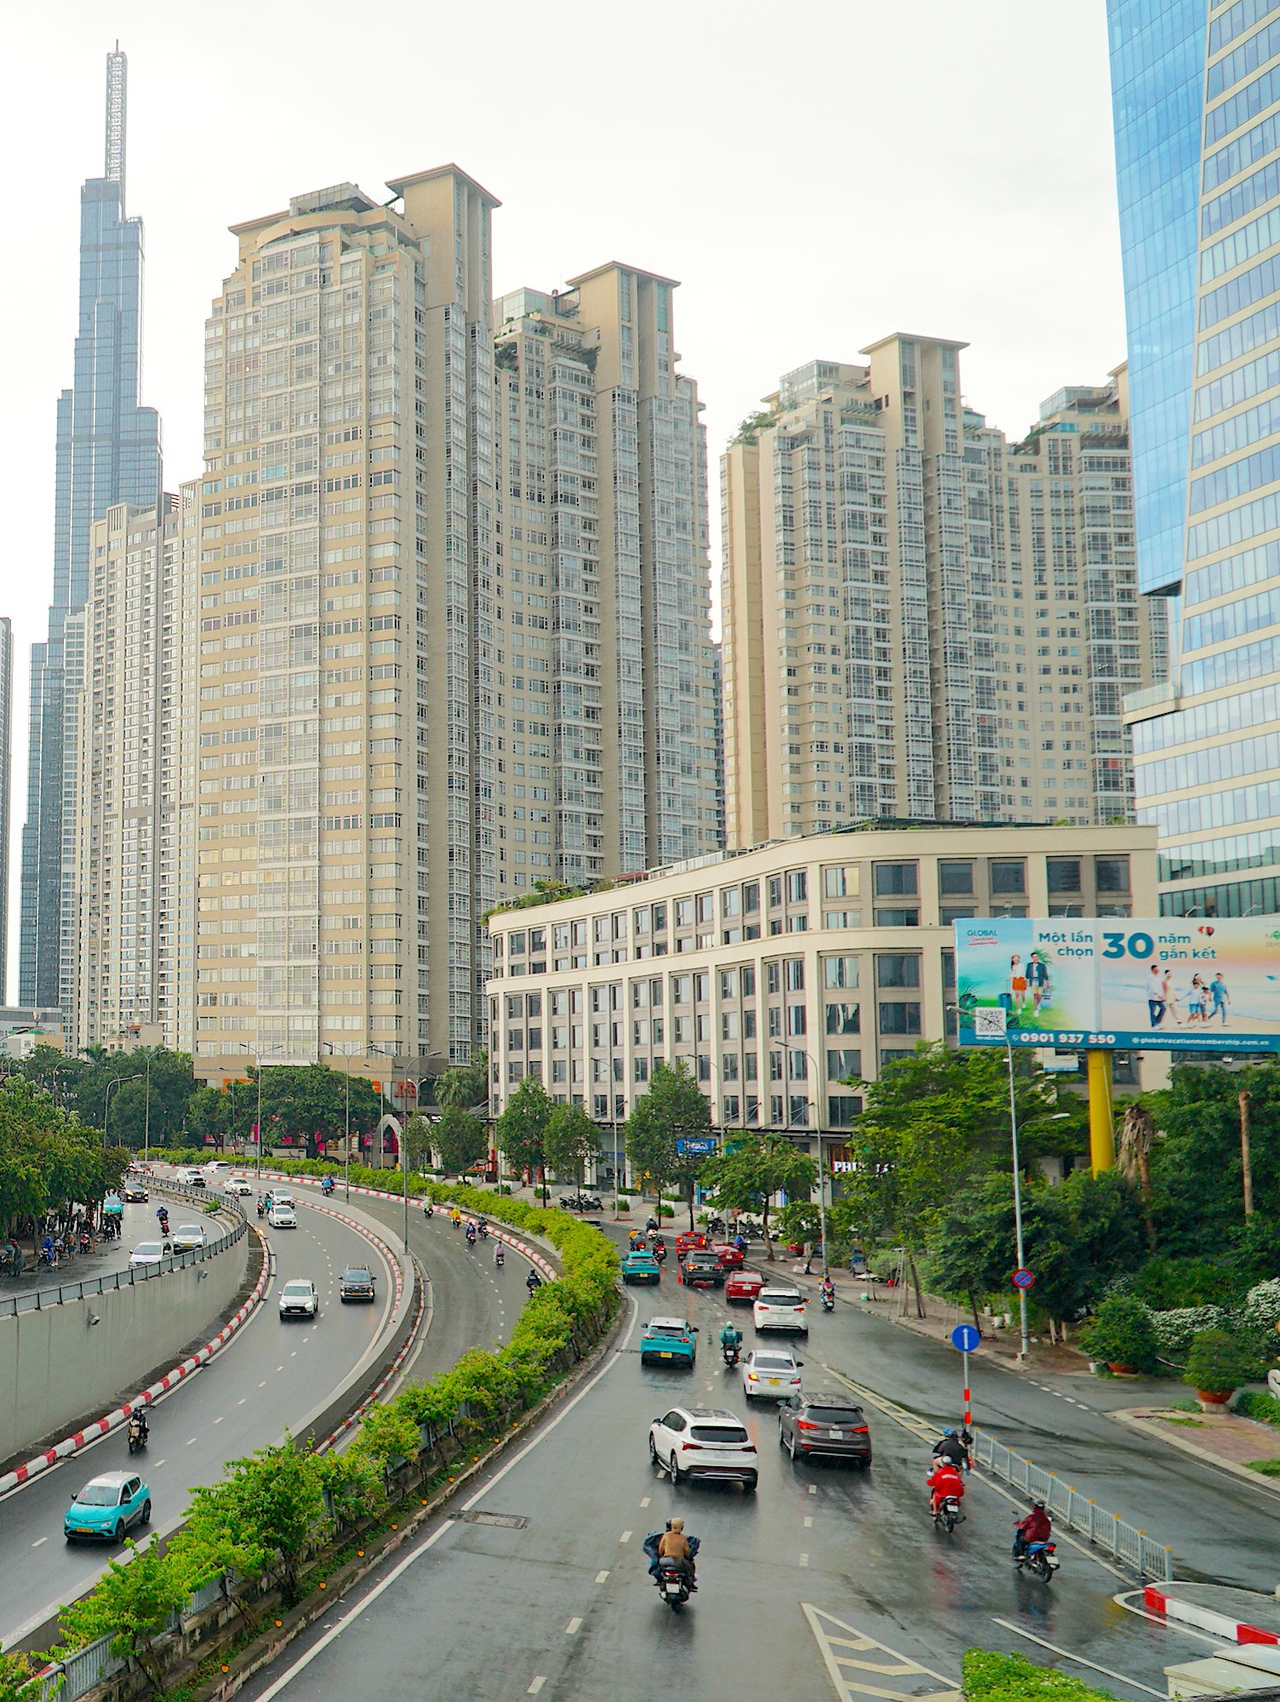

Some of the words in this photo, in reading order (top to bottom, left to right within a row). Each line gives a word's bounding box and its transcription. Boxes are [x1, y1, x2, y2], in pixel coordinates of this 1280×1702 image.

[967, 929, 998, 937] GLOBAL
[1038, 931, 1067, 946] Một
[1102, 932, 1154, 959] 30
[1158, 932, 1191, 943] năm
[1057, 946, 1094, 959] chọn
[1192, 946, 1217, 959] kết
[1020, 1032, 1055, 1043] 0901
[1058, 1033, 1084, 1043] 937
[1088, 1034, 1116, 1044] 550
